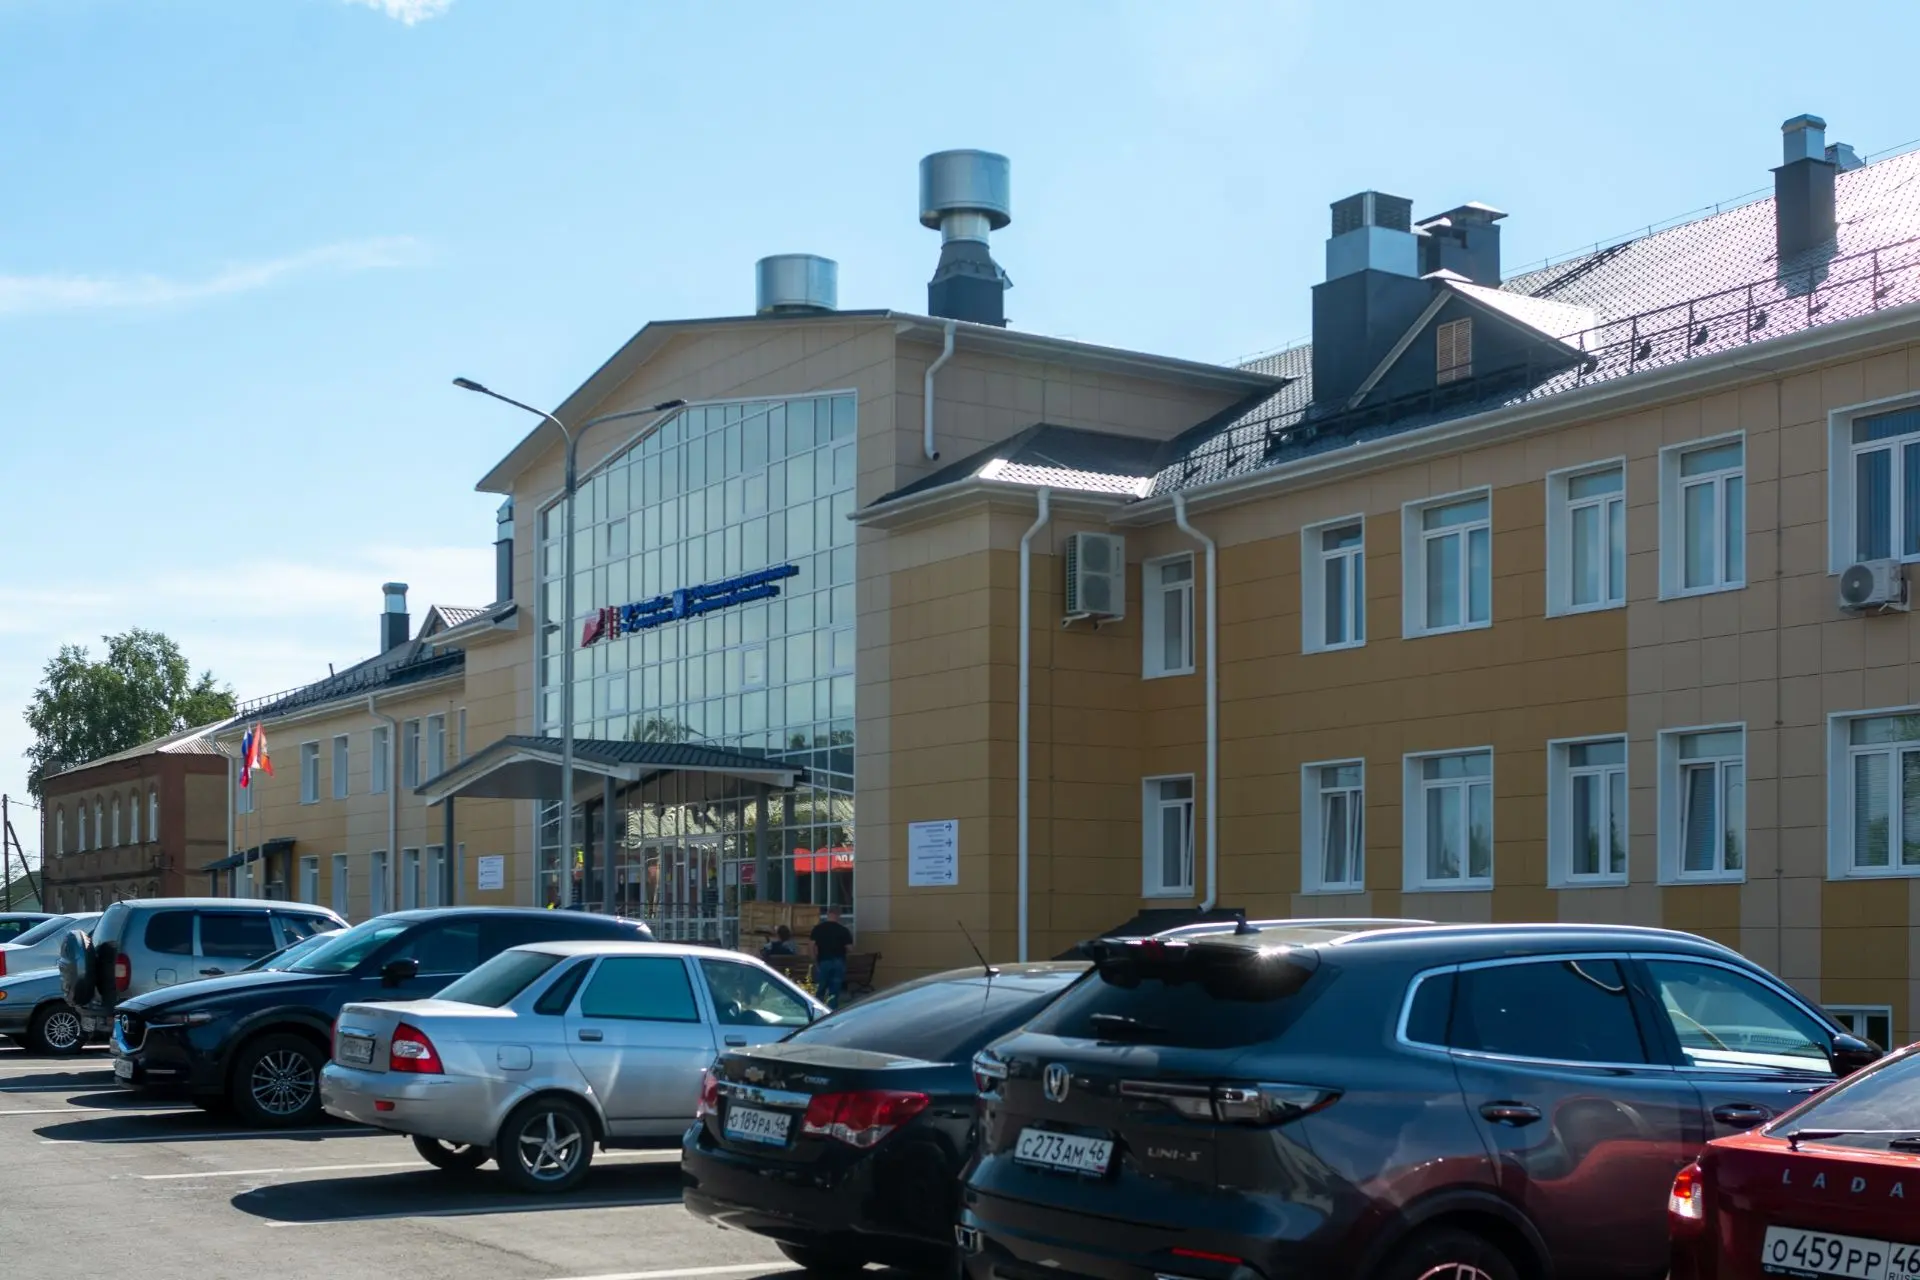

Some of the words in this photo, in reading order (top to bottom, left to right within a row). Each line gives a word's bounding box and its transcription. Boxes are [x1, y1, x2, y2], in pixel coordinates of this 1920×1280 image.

[1088, 1141, 1105, 1161] 46
[1782, 1168, 1904, 1198] LADA
[1892, 1246, 1920, 1274] 46
